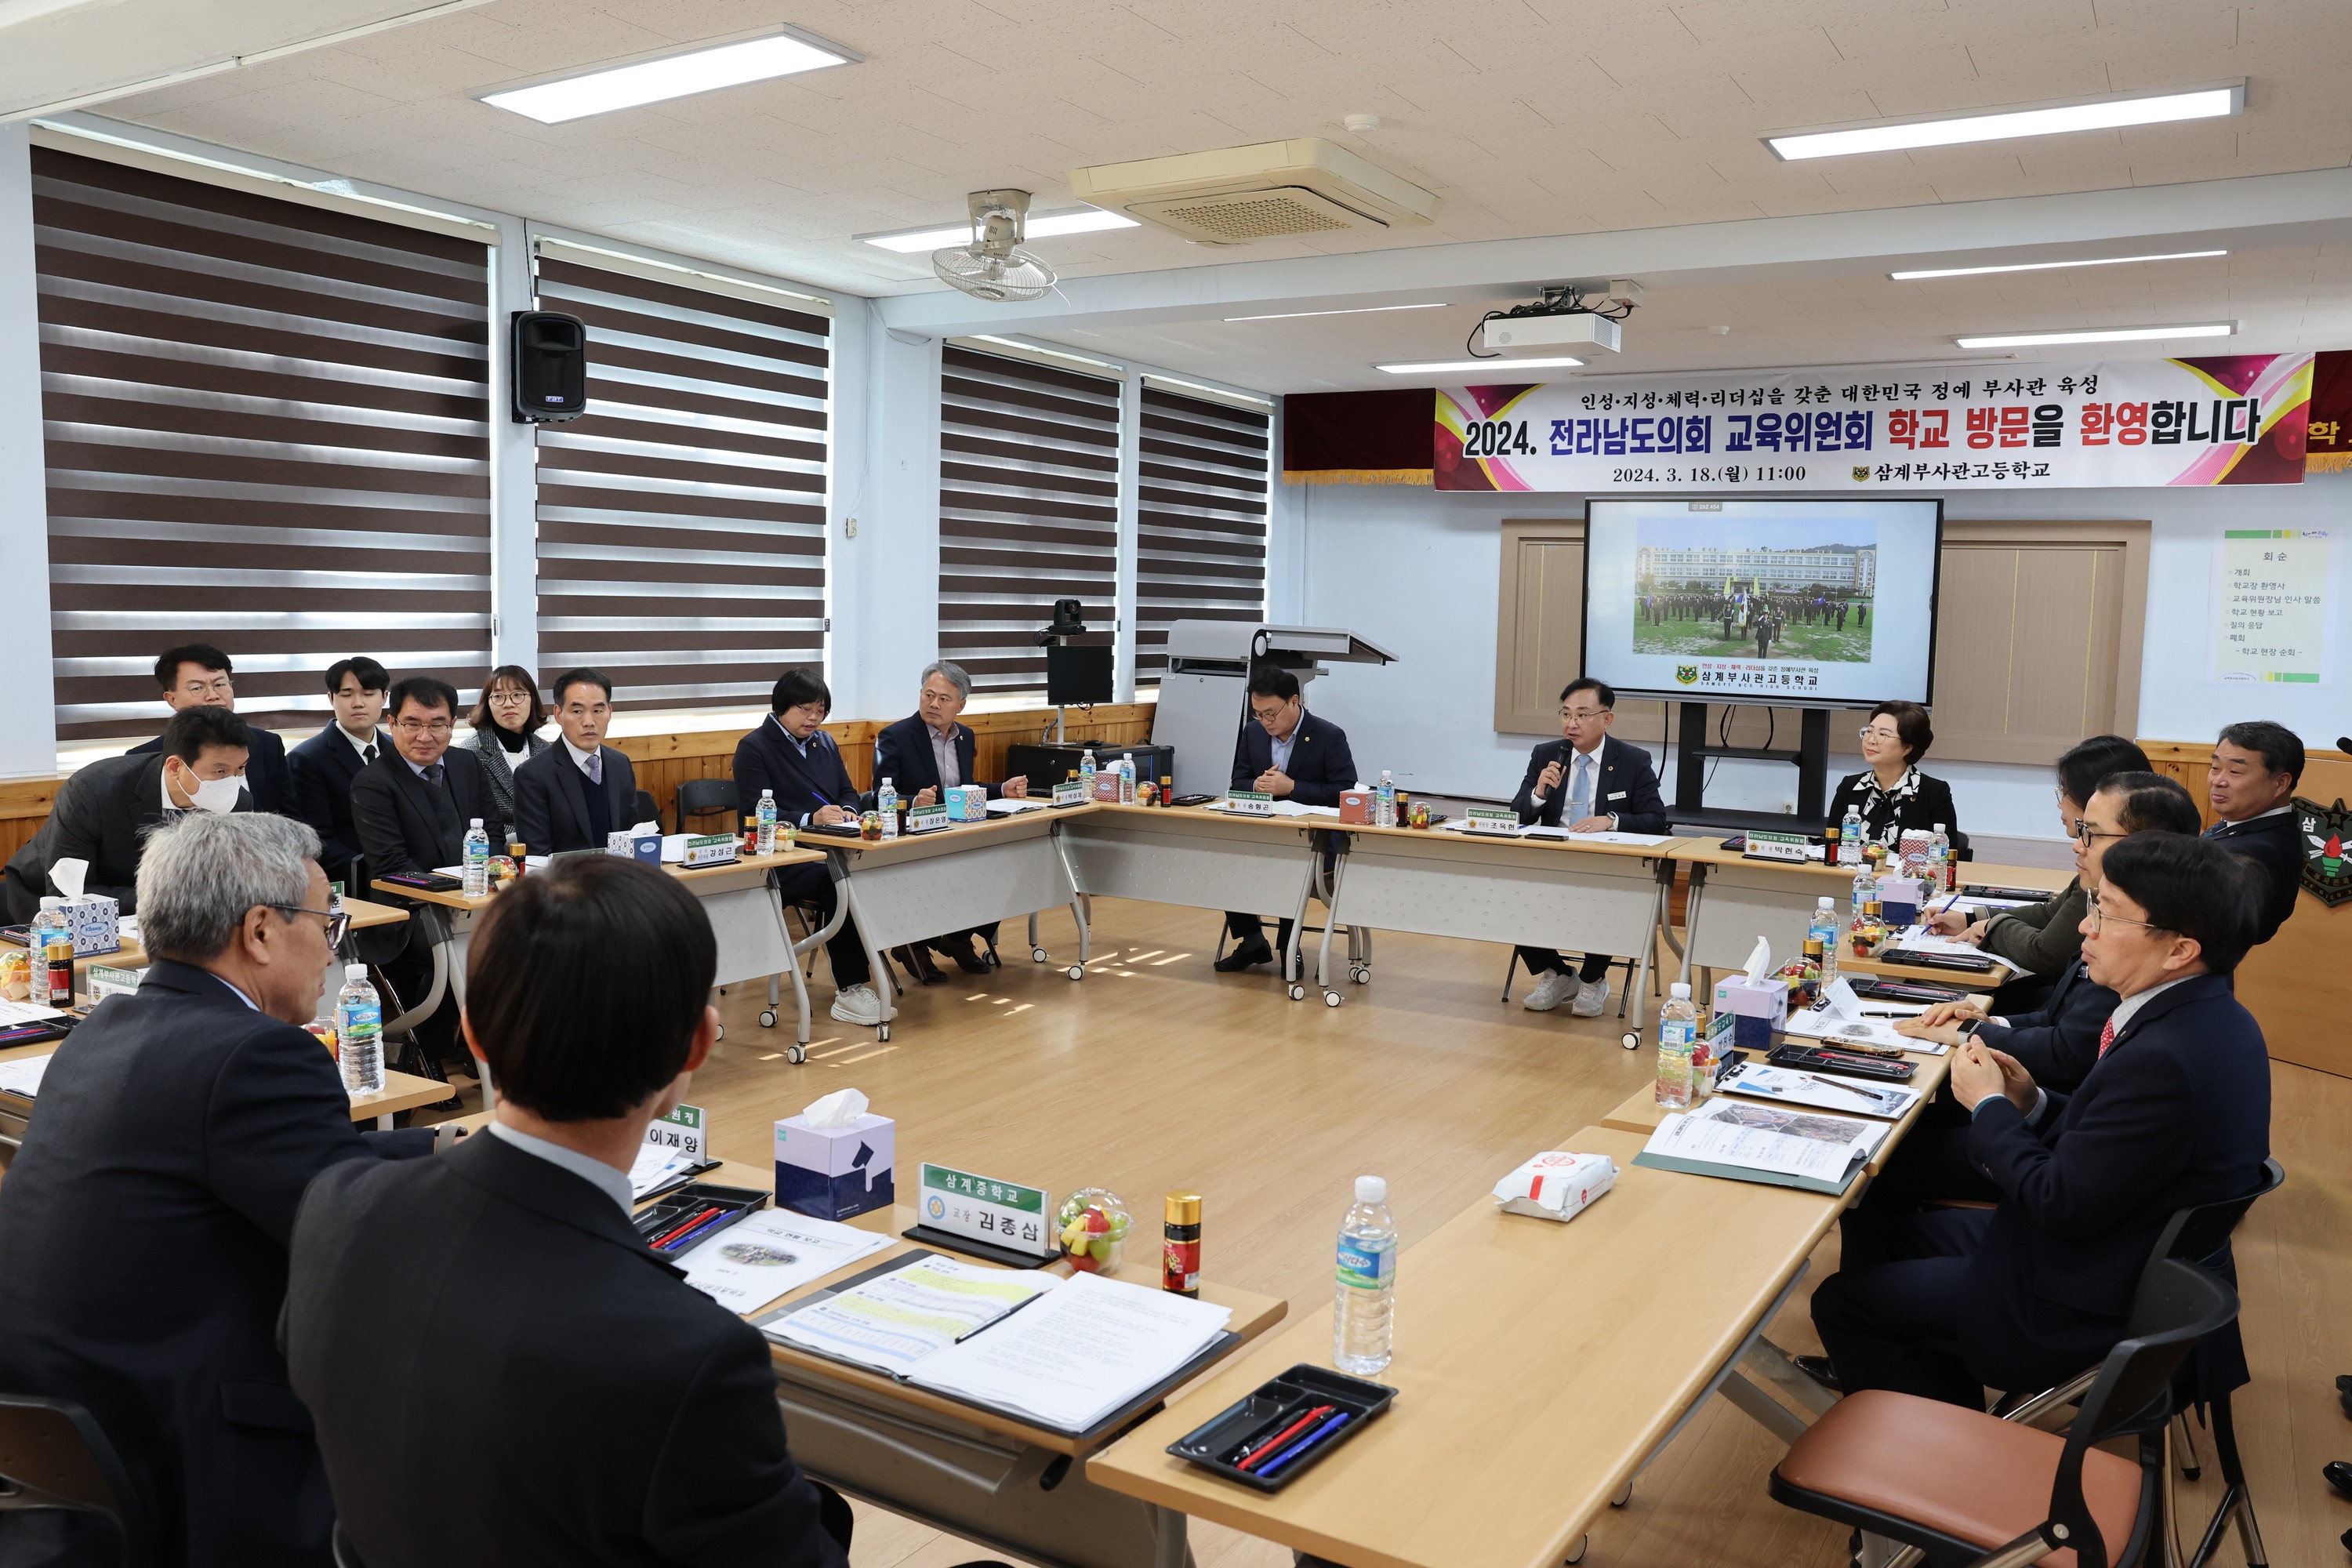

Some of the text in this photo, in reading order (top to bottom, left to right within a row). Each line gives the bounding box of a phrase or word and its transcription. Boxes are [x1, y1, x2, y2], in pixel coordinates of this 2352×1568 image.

[1581, 374, 2099, 411] 인성·지성·체력·리더십을 갖춘 대한민국 정예 부사관 육성
[1464, 397, 2261, 456] 2024. 전라남도의회 교육위원회 학교 방문을 환영합니다
[1613, 460, 2051, 483] 2024. 3. 18.(월) 11:00 삼계부사관고등학교
[2233, 582, 2285, 590] 학교장 환영사
[2232, 595, 2321, 604] 교육위원장님 인사 말씀
[2250, 608, 2265, 617] 현황
[2230, 621, 2263, 630] 질의 응답
[2260, 648, 2277, 656] 현장
[1490, 822, 1515, 831] 조옥현
[2302, 817, 2316, 833] 삼
[710, 847, 732, 858] 강성근
[1774, 846, 1803, 856] 박현숙
[93, 967, 137, 985] 삼계부사관고등학
[650, 1128, 698, 1153] 이재양
[946, 1173, 1018, 1203] 삼계중학교
[953, 1207, 1039, 1243] 교장 김종삼
